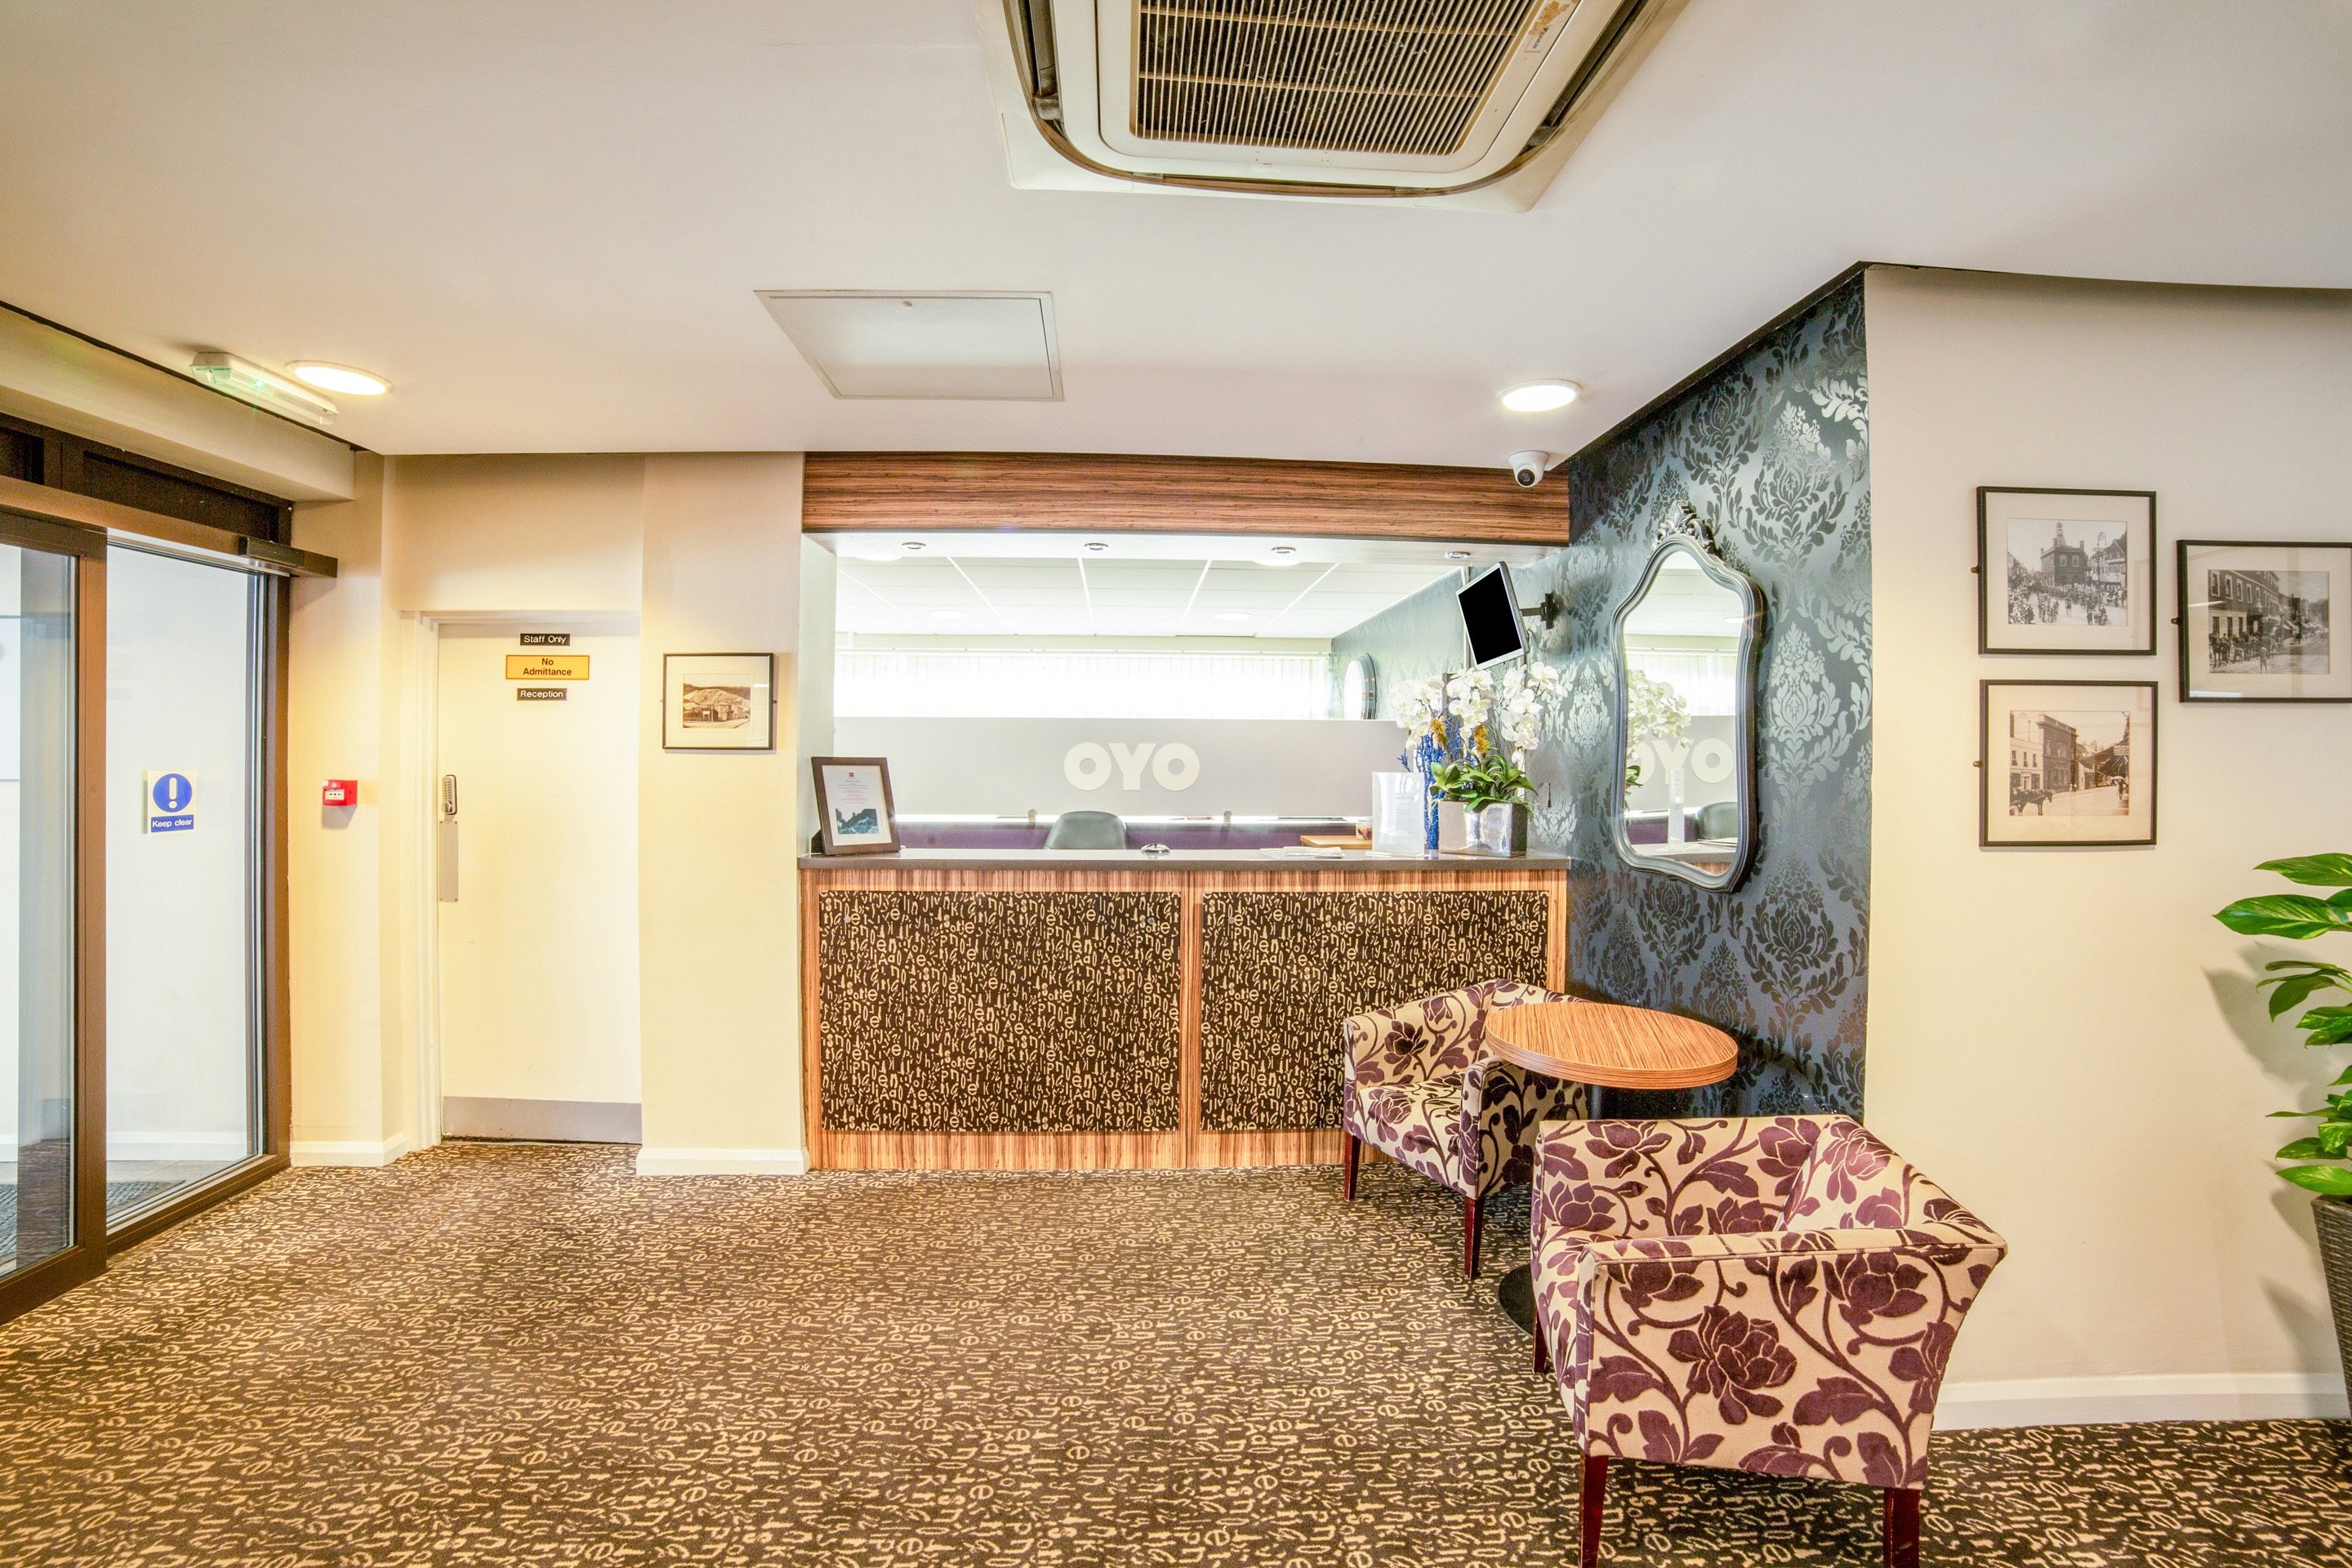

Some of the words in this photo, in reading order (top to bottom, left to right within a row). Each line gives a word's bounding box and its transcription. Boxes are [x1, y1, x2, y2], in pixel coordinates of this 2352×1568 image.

[547, 635, 567, 644] Only
[541, 657, 554, 666] No
[523, 667, 572, 676] Admittance
[520, 690, 564, 698] Reception
[1063, 742, 1200, 791] OYO
[152, 820, 172, 828] Keep
[174, 818, 193, 826] clear
